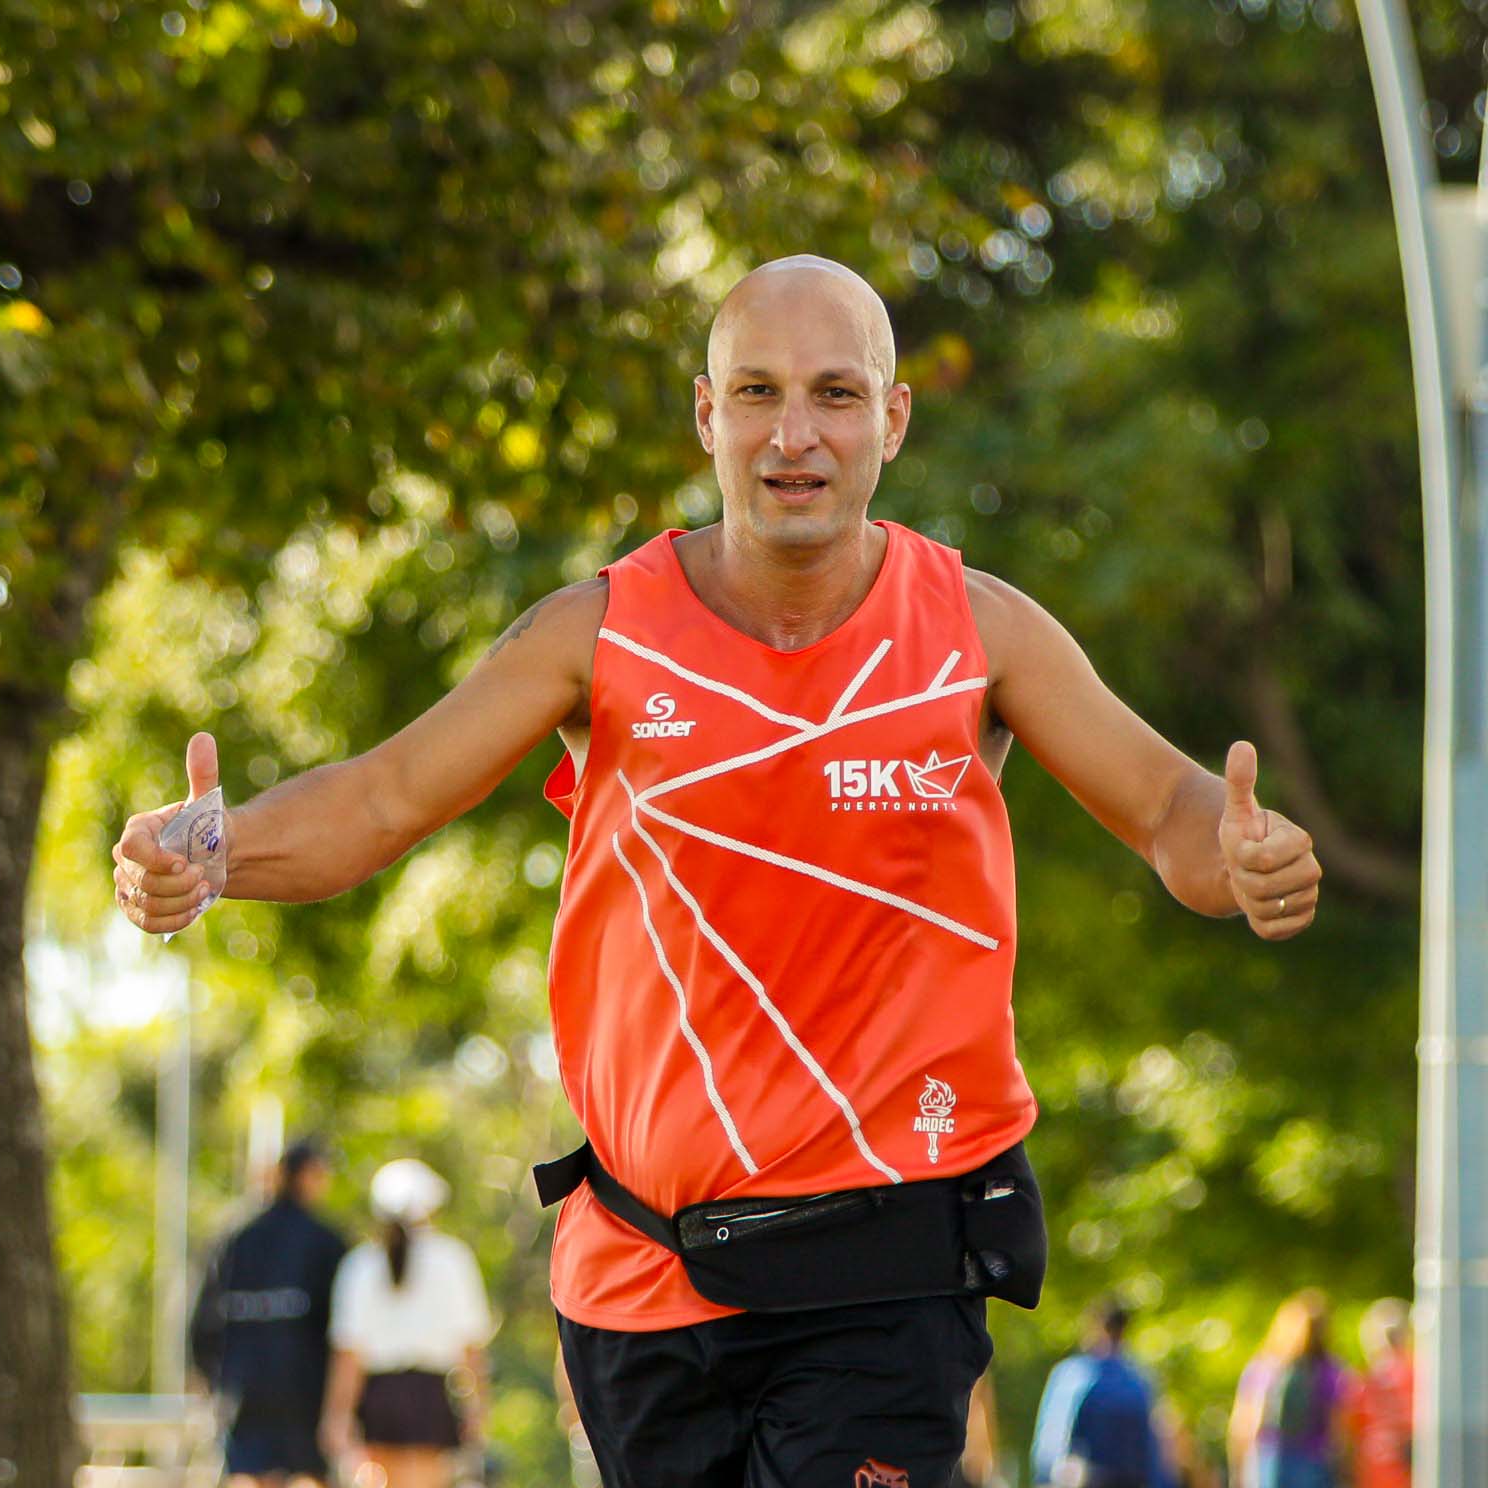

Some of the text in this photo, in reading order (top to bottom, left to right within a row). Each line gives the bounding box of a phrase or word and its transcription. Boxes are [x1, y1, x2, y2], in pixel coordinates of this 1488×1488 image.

[823, 760, 901, 798] 15K
[831, 802, 901, 812] PUERTO
[913, 1116, 955, 1134] ARDEC
